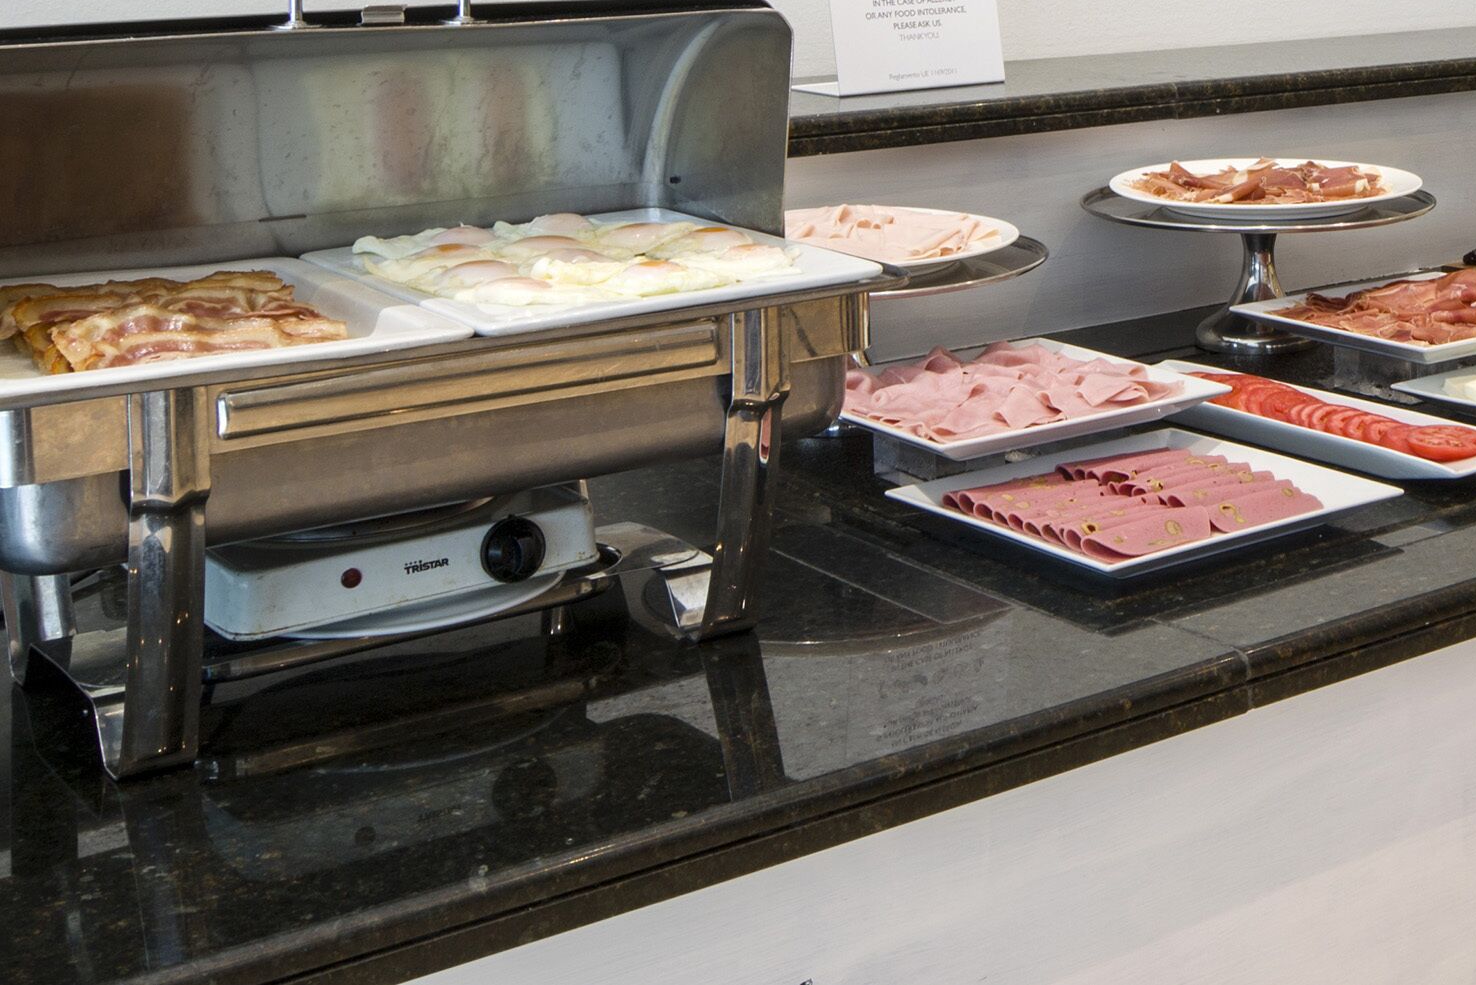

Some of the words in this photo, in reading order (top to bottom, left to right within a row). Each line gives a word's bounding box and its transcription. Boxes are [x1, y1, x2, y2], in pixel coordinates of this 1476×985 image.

[873, 0, 881, 7] IN
[881, 0, 896, 7] THE
[865, 12, 877, 20] OR
[877, 11, 892, 19] ANY
[894, 9, 916, 18] FOOD
[893, 20, 917, 30] PLEASE
[918, 19, 930, 28] ASK
[403, 557, 449, 575] TRISTAR
